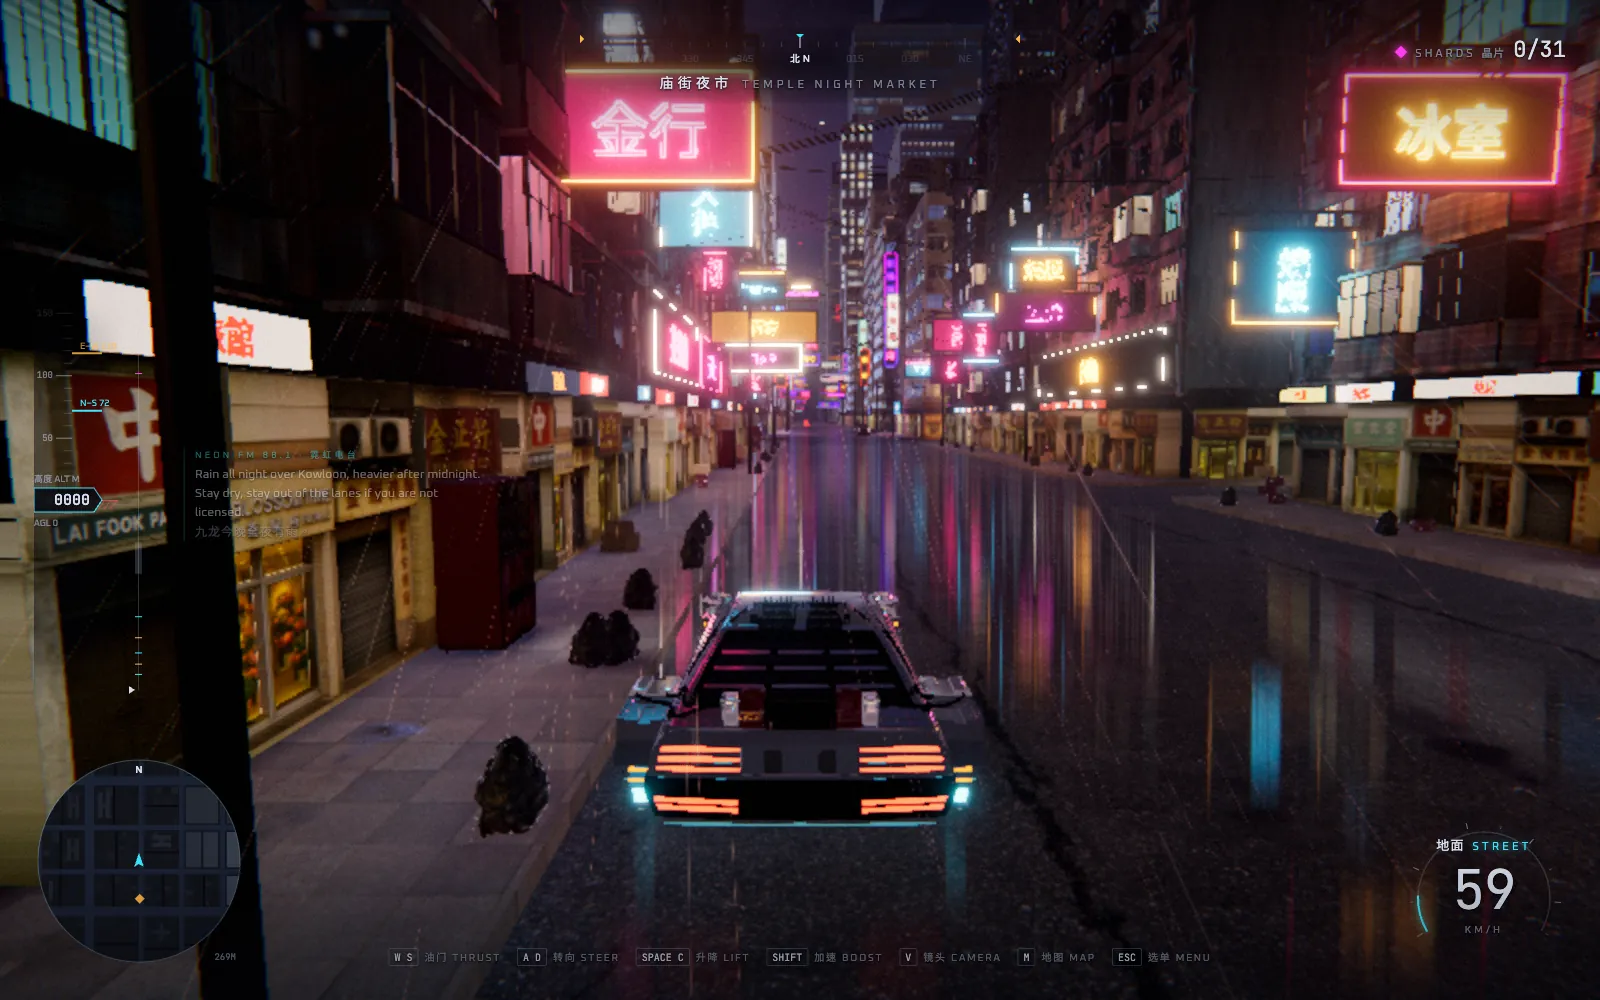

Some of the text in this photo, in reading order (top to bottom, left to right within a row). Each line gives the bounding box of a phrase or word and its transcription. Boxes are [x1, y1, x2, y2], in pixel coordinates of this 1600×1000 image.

[592, 99, 707, 159] 金行
[1394, 103, 1508, 161] 冰室
[1423, 408, 1447, 435] 中
[53, 523, 89, 545] LAI
[95, 514, 145, 537] FOOK
